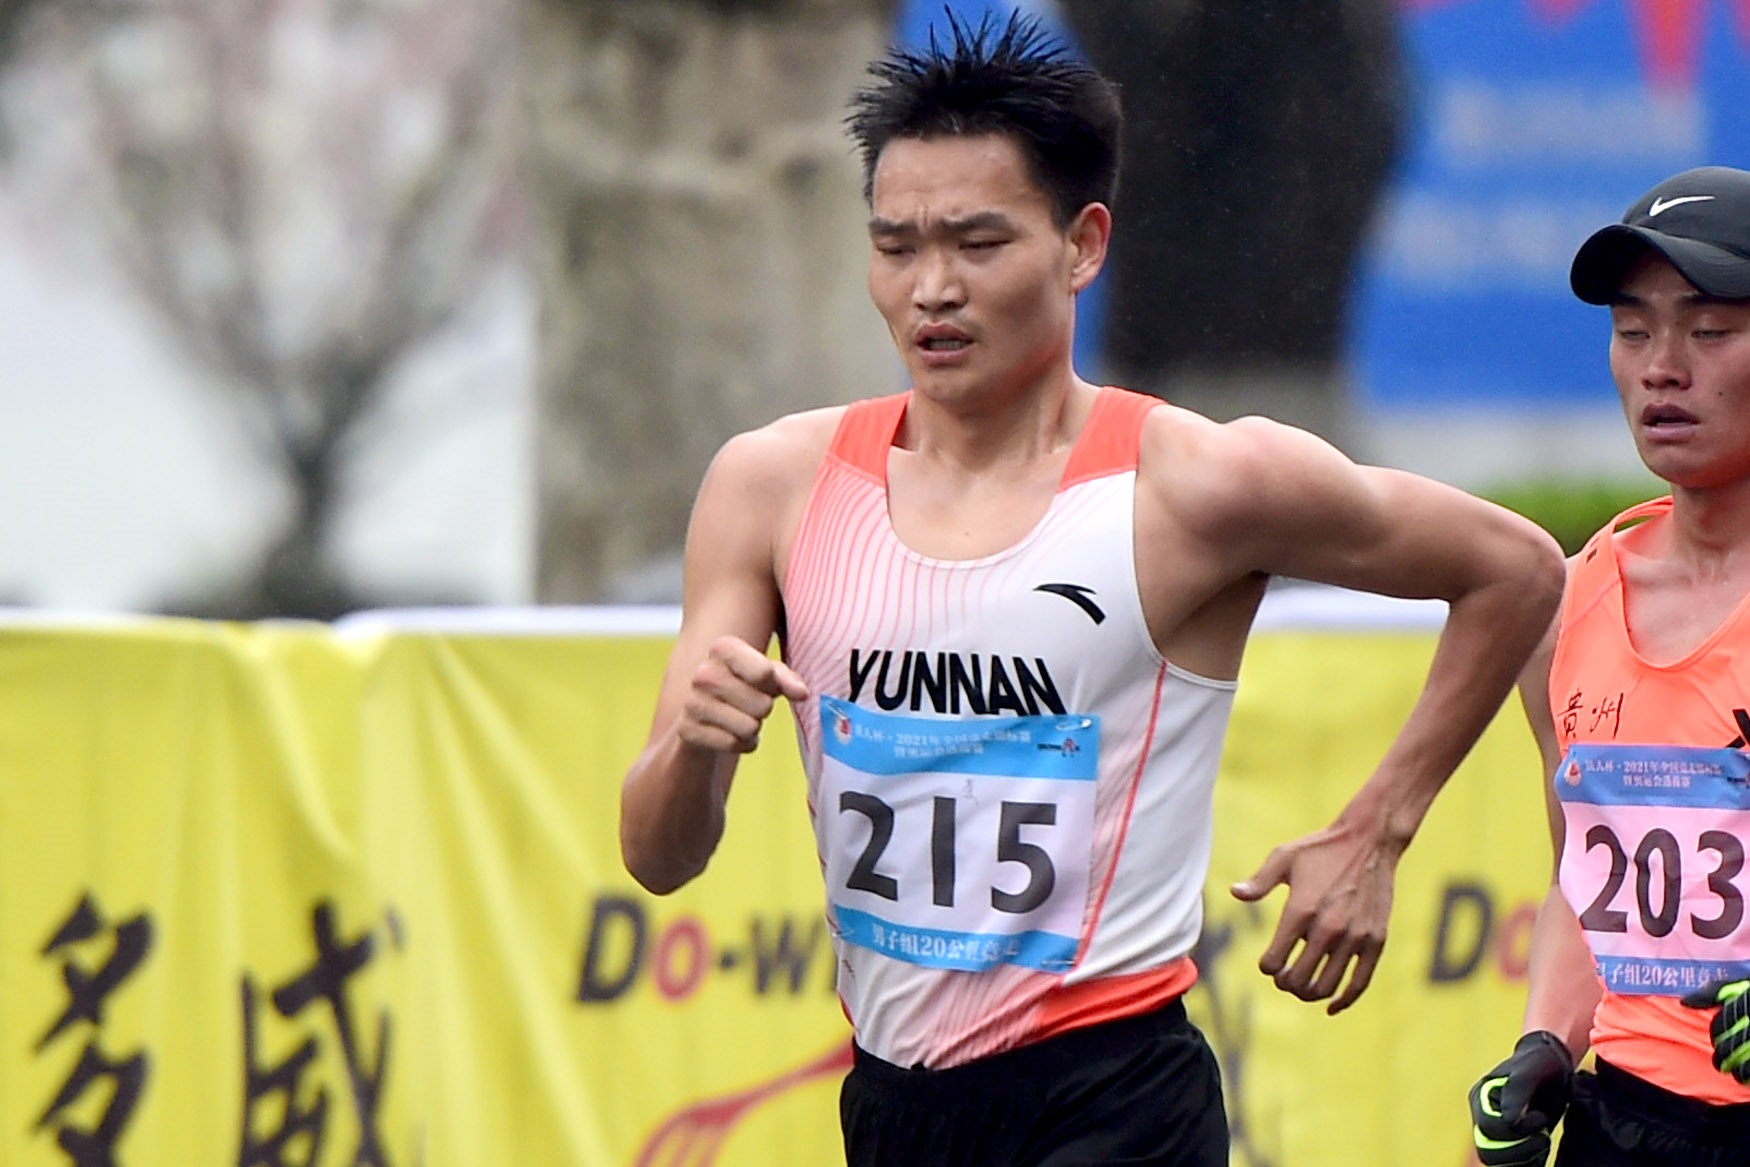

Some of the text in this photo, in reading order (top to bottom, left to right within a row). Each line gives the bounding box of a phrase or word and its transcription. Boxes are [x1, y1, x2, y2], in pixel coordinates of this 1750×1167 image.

[848, 648, 1067, 717] YUNNAN
[839, 791, 1056, 914] 215
[1579, 825, 1745, 939] 203
